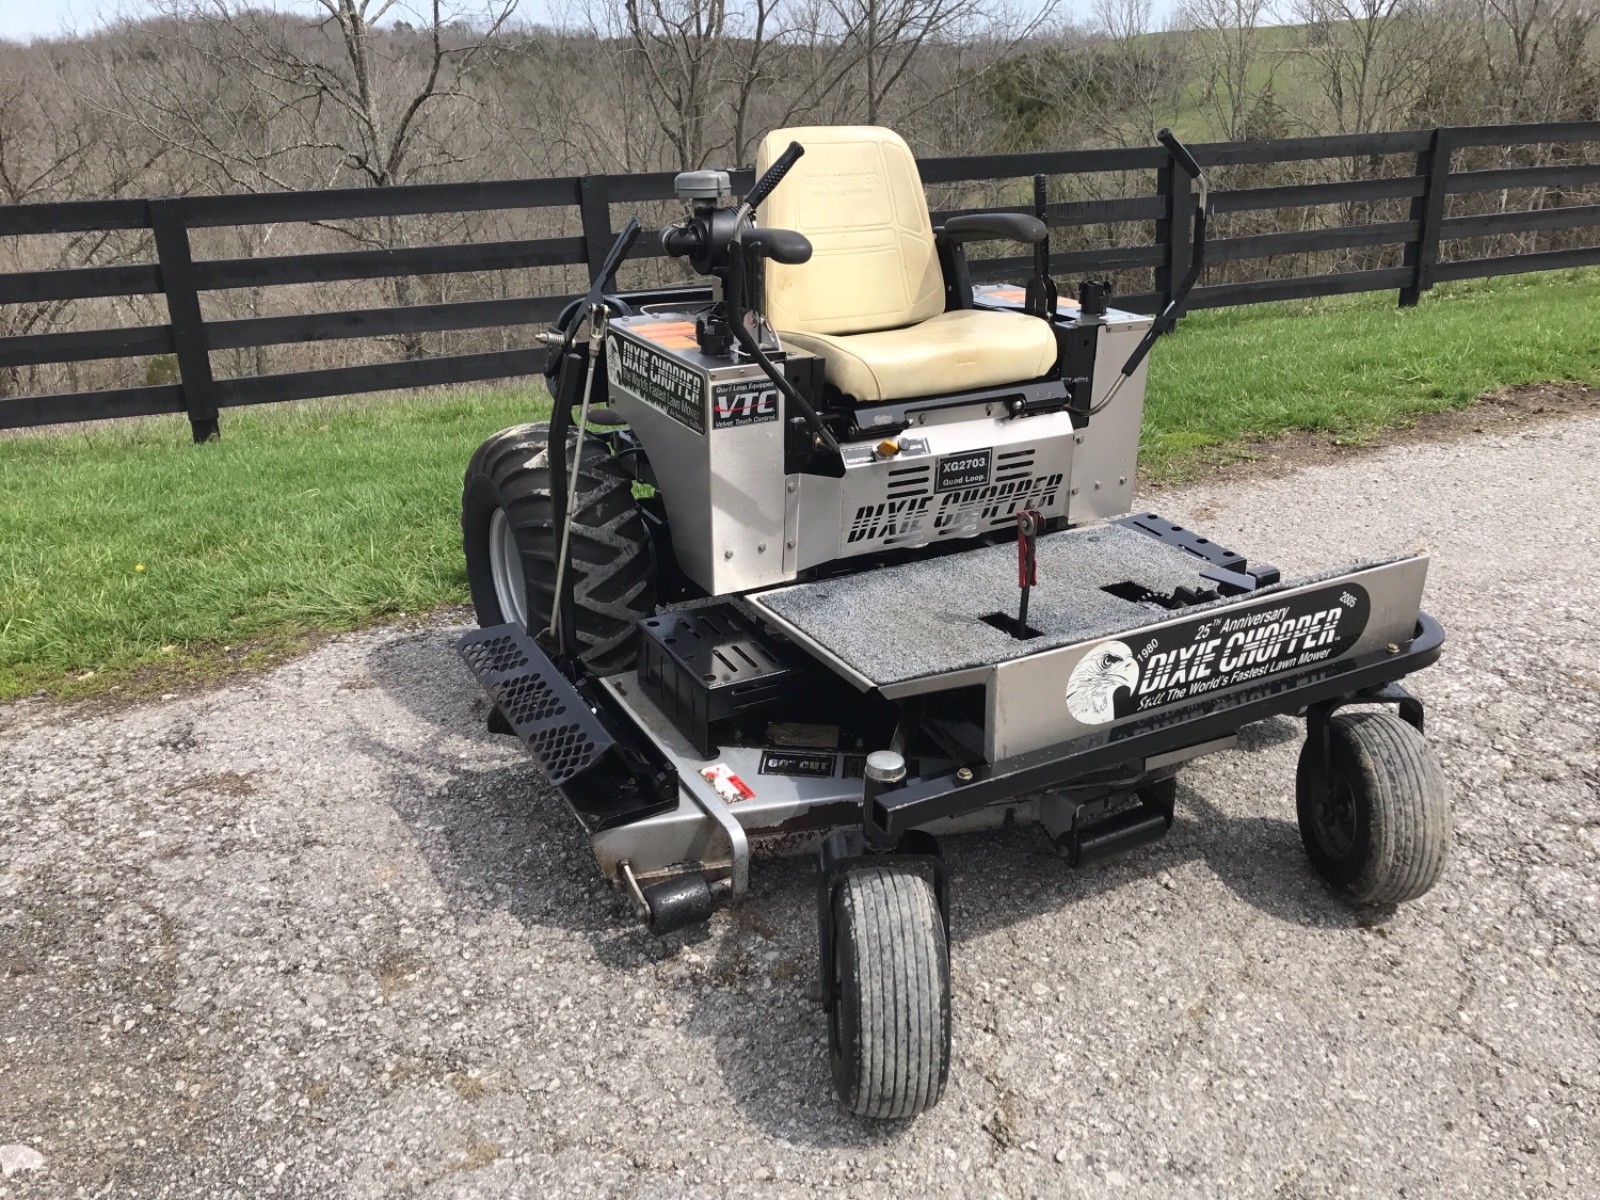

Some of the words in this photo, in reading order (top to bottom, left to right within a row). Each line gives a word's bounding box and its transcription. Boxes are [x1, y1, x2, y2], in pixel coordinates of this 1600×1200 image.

[623, 341, 649, 377] DIXIE
[650, 355, 701, 405] CHOPPER
[748, 382, 774, 390] Equipped
[649, 382, 666, 402] Fastest
[667, 390, 680, 408] Lawn
[681, 399, 701, 419] Mower
[718, 390, 776, 419] VTC
[716, 420, 733, 428] Velvet
[735, 417, 752, 425] Touch
[943, 457, 986, 473] XG2703
[943, 477, 963, 486] Quad
[847, 496, 934, 543] DIXIE
[935, 473, 1063, 528] CHOPPER
[1339, 591, 1358, 608] 2005
[1220, 606, 1291, 634] Anniversary
[1136, 638, 1159, 663] 1980
[1138, 638, 1222, 696] DIXIE
[1219, 607, 1343, 672] CHOPPER
[1136, 692, 1166, 711] Still
[1167, 687, 1187, 702] The
[1189, 674, 1229, 695] World's
[1230, 666, 1269, 684] Fastest
[1269, 657, 1296, 672] Lawn
[1298, 648, 1332, 665] Mower
[799, 760, 829, 770] CUT
